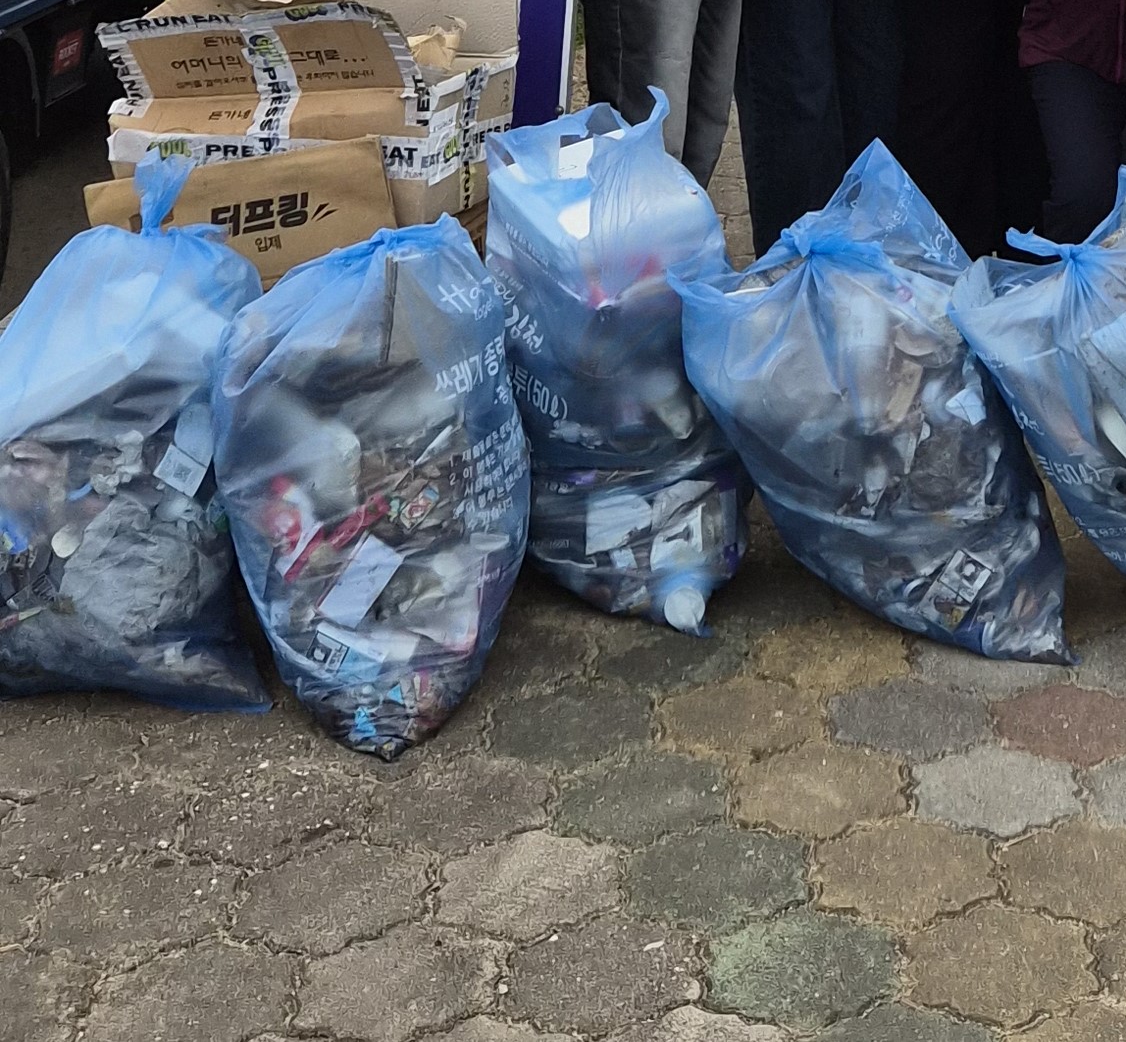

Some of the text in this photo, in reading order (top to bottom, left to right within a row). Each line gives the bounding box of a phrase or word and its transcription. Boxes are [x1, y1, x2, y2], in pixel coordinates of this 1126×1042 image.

[171, 55, 243, 74] 어머니의
[211, 191, 309, 237] 더프킹
[254, 235, 282, 253] 입제
